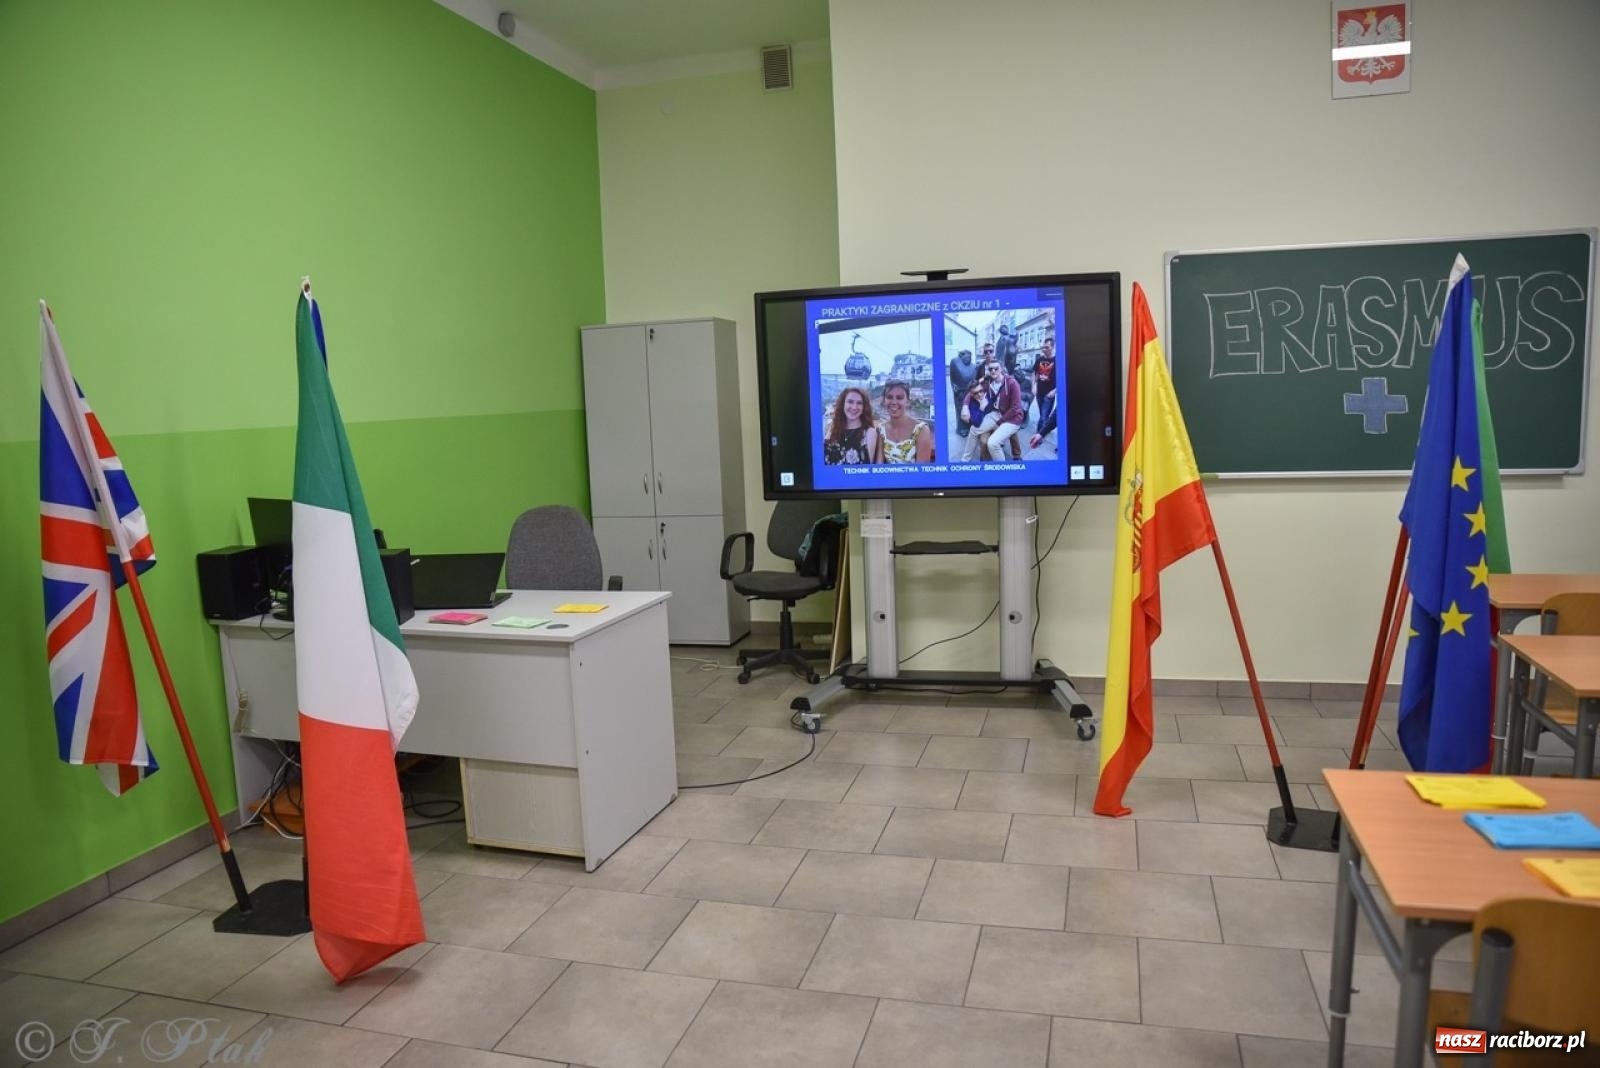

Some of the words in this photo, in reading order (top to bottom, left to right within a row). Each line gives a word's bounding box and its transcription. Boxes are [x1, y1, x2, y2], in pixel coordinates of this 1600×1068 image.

[821, 306, 868, 317] PRAKTYKI
[870, 302, 941, 315] ZAGRANICZNE
[982, 300, 993, 309] nr
[1203, 271, 1585, 379] ERASMUS
[1343, 377, 1408, 434] +
[921, 465, 948, 473] TECHNIK
[950, 464, 981, 472] OCHRONY
